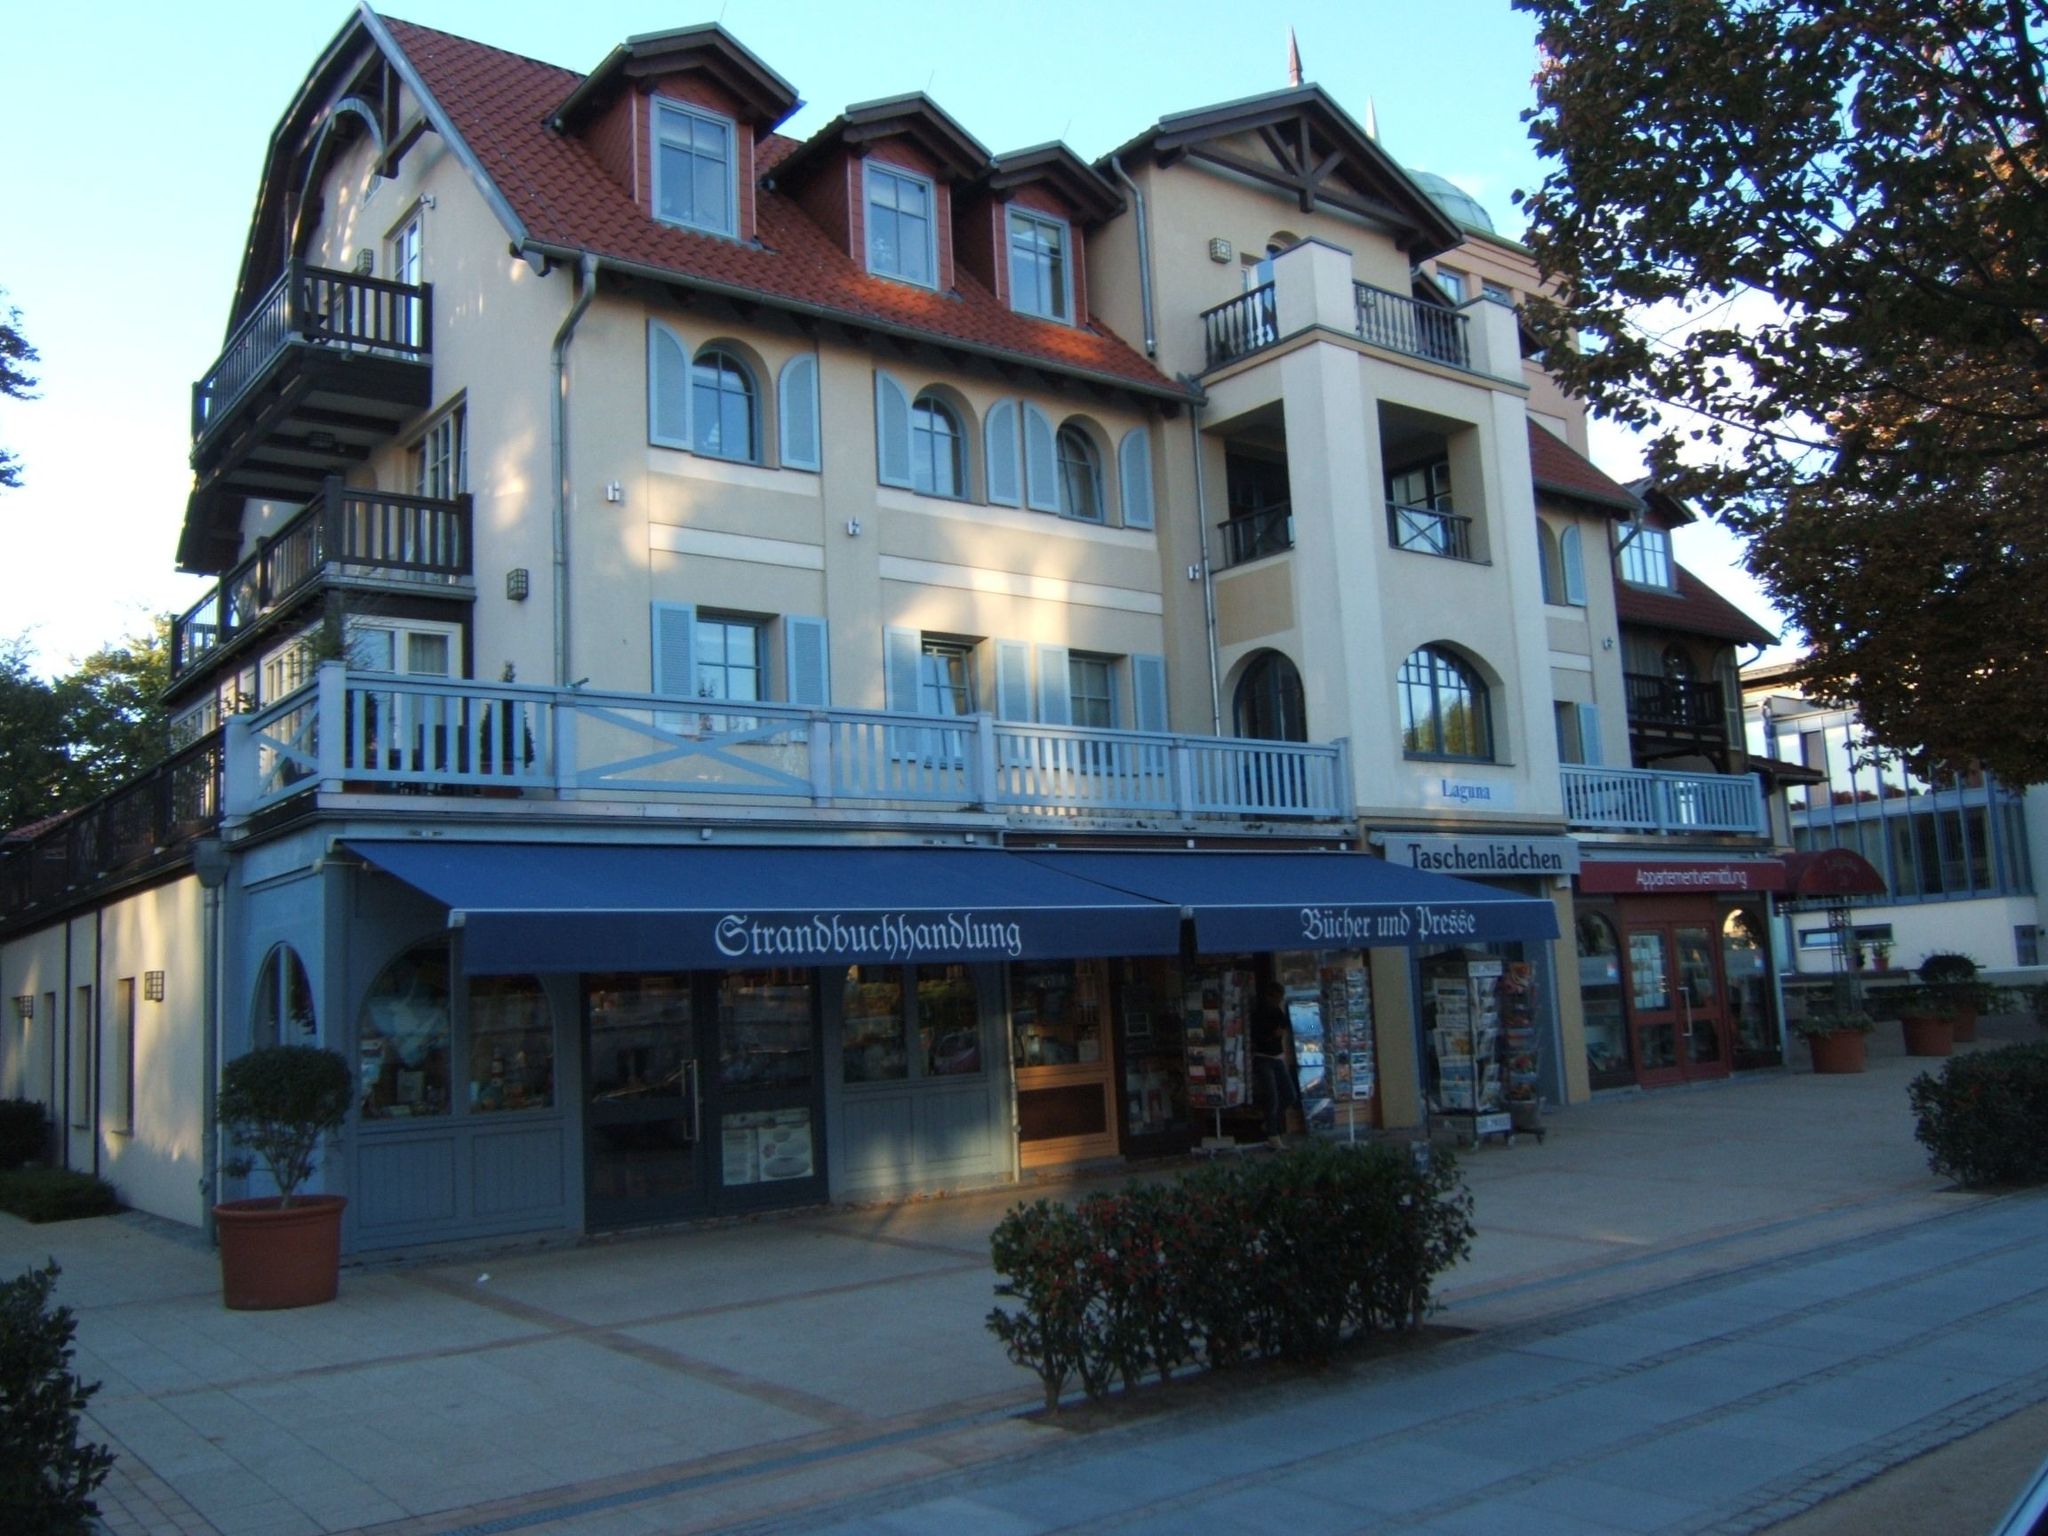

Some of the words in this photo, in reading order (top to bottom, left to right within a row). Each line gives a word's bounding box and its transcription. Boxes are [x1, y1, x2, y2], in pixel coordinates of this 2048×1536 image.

[1441, 779, 1490, 803] Laguna
[1408, 843, 1562, 870] Taschenlädchen
[1636, 867, 1747, 891] Appartementvermittlung
[715, 912, 1022, 959] Strandbuchhandlung
[1301, 907, 1370, 944] Bücher
[1377, 906, 1411, 937] und
[1415, 905, 1476, 941] Presse
